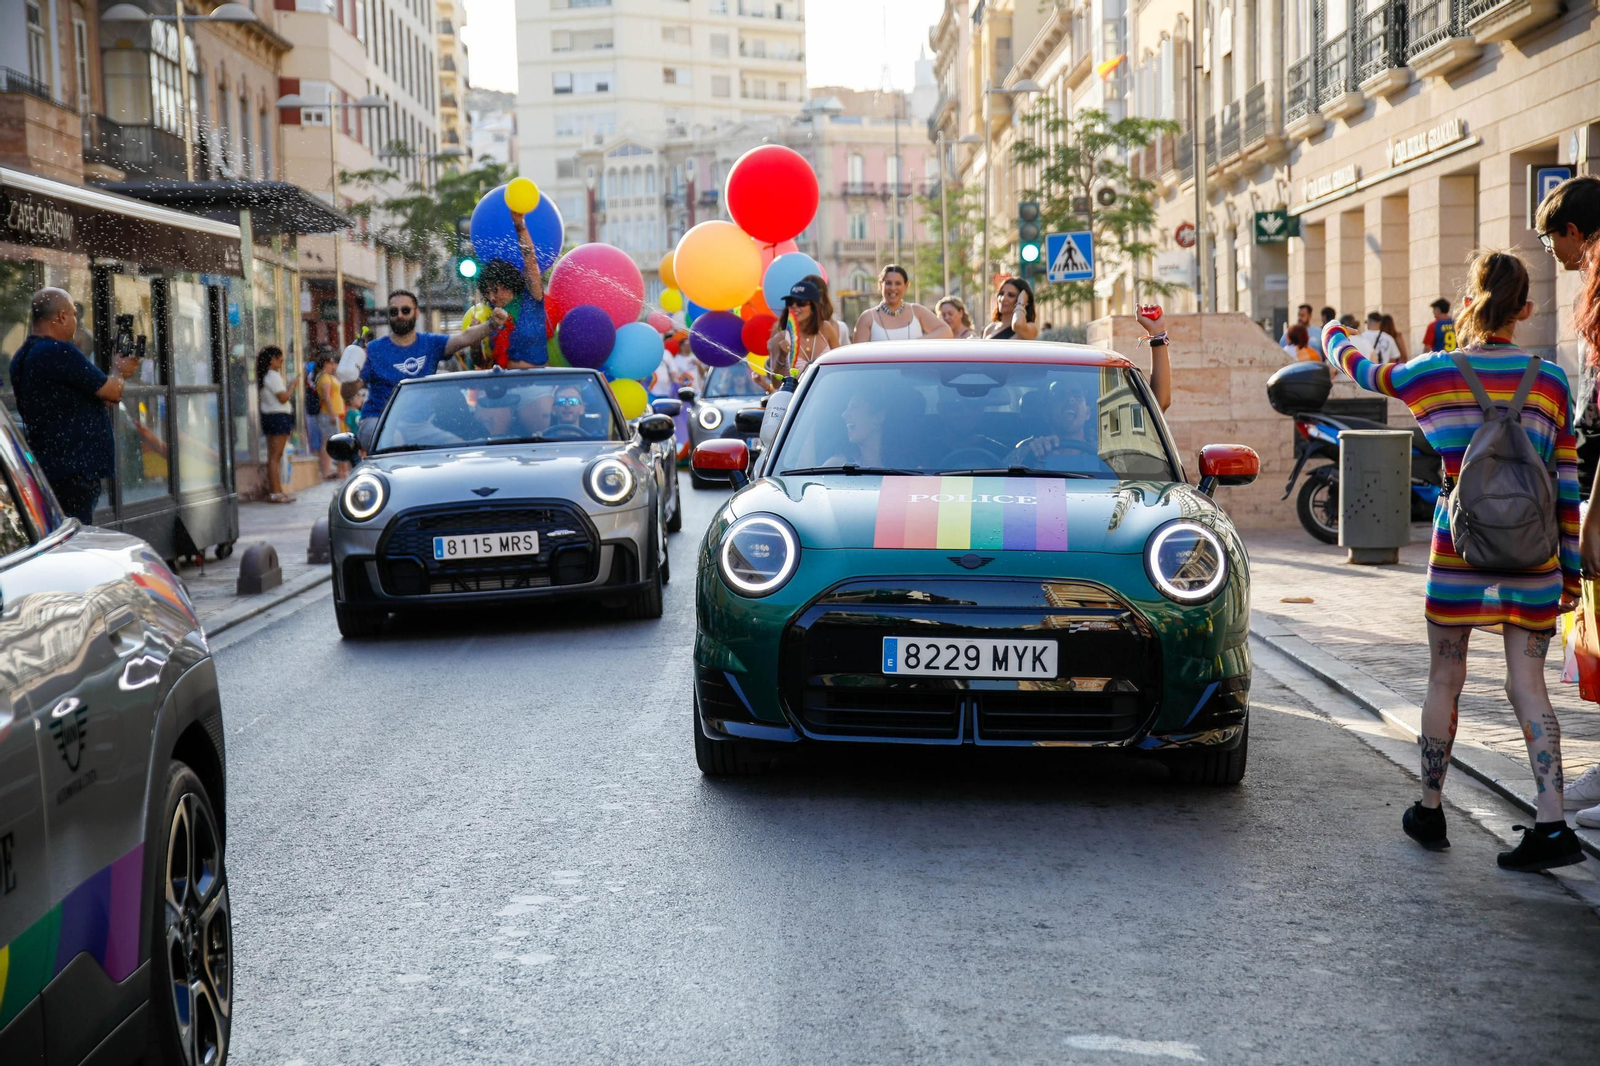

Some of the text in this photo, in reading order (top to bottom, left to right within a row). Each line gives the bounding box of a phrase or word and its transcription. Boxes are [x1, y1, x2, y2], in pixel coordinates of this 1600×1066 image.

[1444, 331, 1456, 352] 9
[907, 493, 1038, 505] POLICE
[447, 535, 533, 556] 8115 MRS
[904, 643, 1049, 673] 8229 MYK
